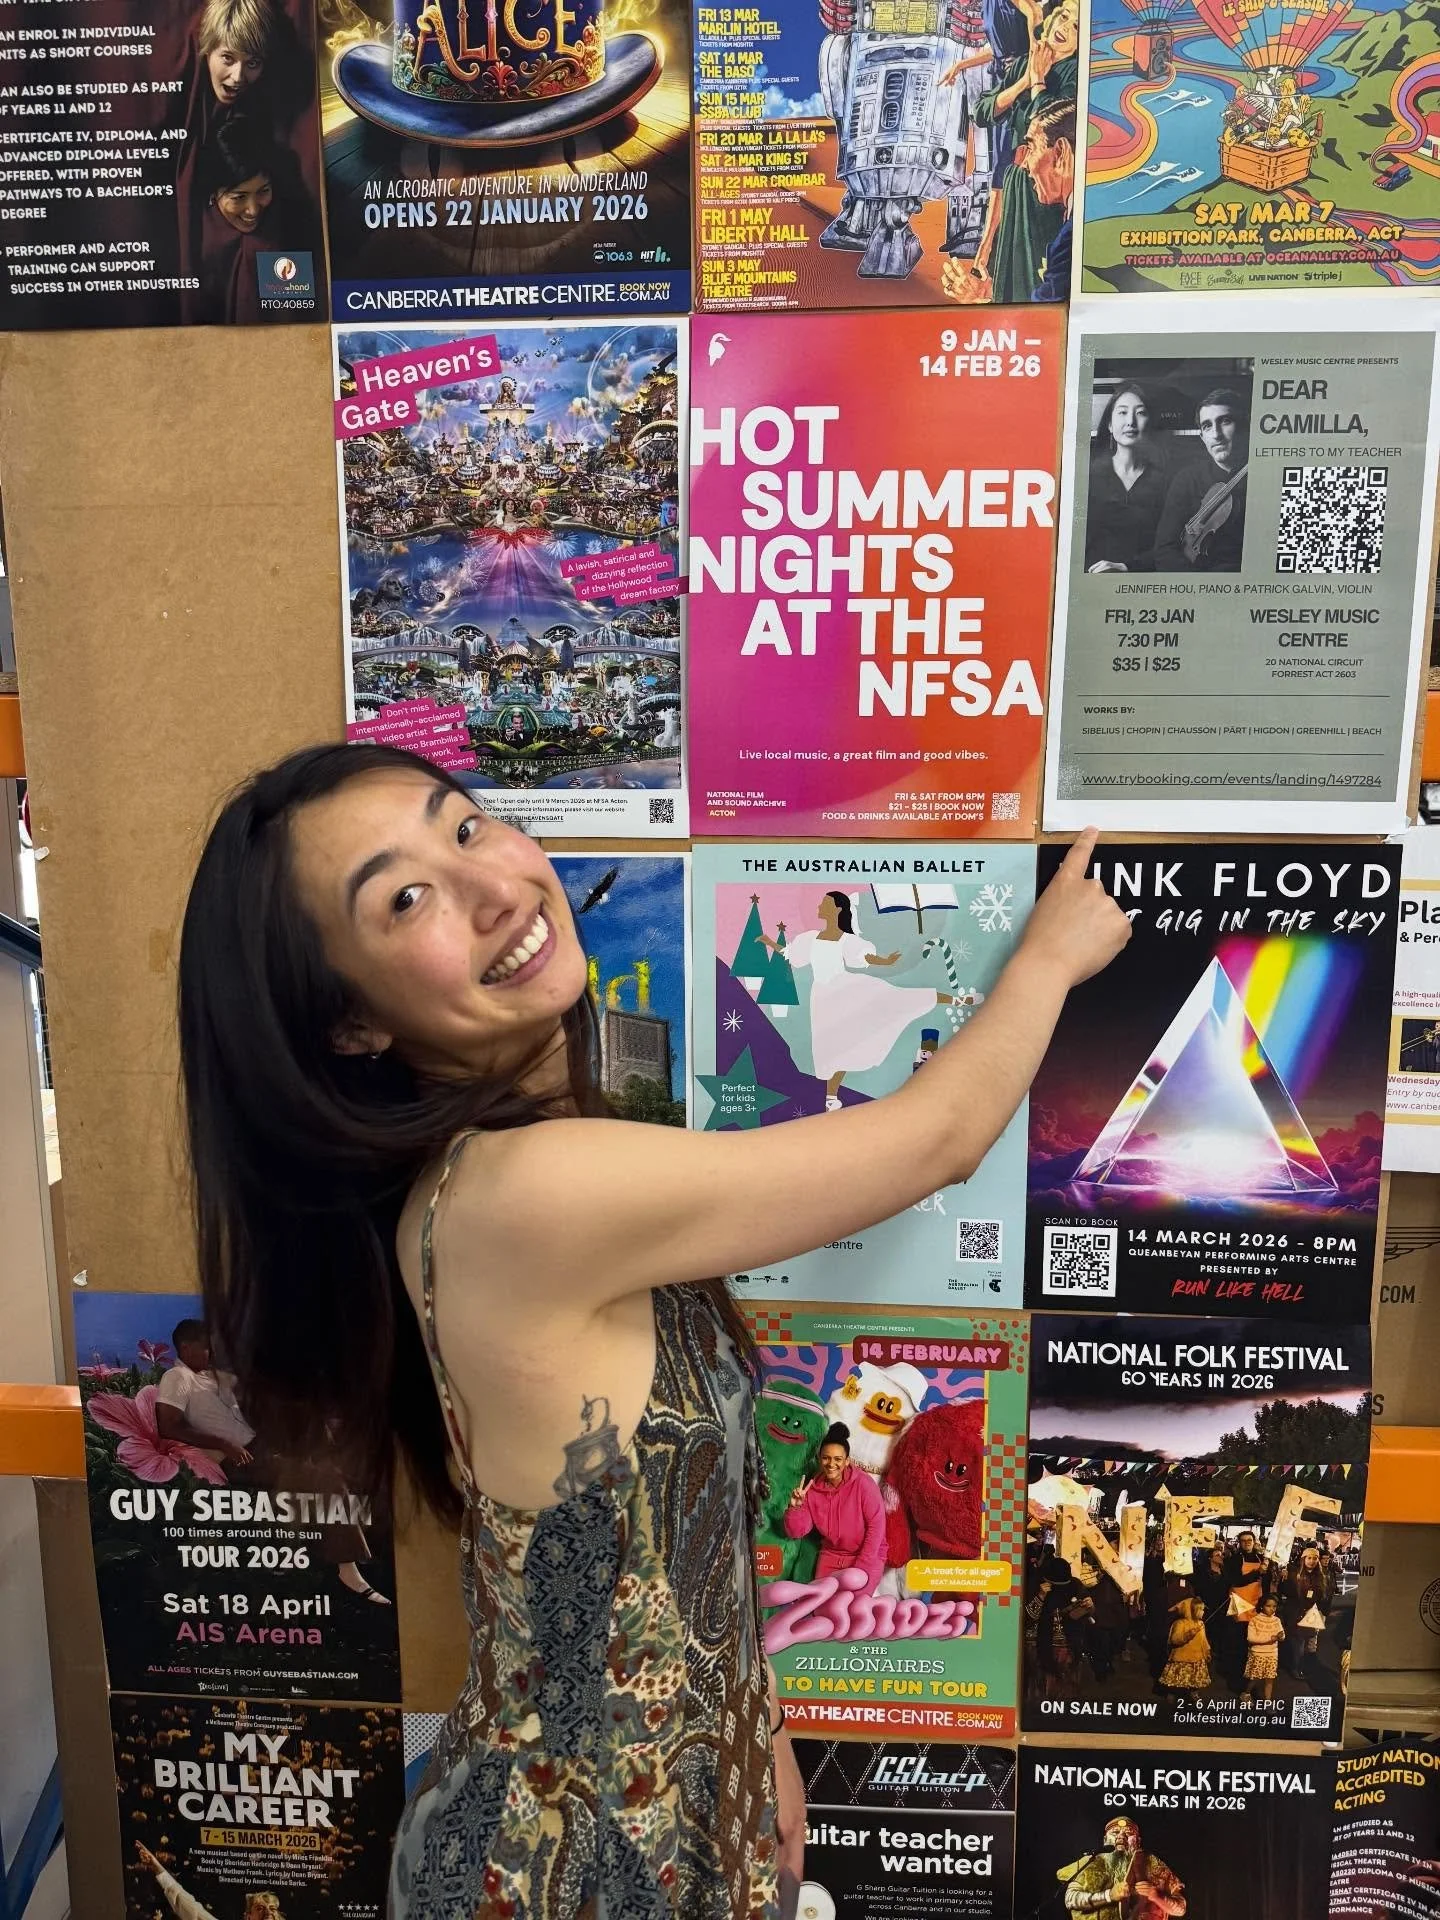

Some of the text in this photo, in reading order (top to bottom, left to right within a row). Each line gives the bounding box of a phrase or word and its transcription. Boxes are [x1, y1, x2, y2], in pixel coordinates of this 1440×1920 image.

[698, 8, 759, 21] FRI 13 MAR
[698, 21, 781, 36] MARLIN HOTEL
[415, 0, 585, 82] ALICE
[364, 171, 648, 200] AN ACROBATIC ADVENTURE IN WONDERLAND
[1, 207, 47, 219] DEGREE
[364, 194, 648, 229] OPENS 22 JANUARY 2026
[701, 207, 773, 226] FRI 1 MAY
[1194, 200, 1334, 226] SAT MAR 7
[701, 224, 809, 243] LIBERTY HALL
[1119, 224, 1403, 247] EXHIBITION PARK, CANBERRA, ACT
[605, 251, 633, 261] 106.3
[1124, 249, 1401, 267] TICKETS AVAILABLE AT OCEANALLEY.COM.AU
[10, 277, 199, 294] SUCCESS IN OTHER INDUSTRIES
[702, 270, 796, 285] BLUE MOUNTAINS
[702, 285, 752, 297] THEATRE
[940, 329, 957, 351] 9
[963, 329, 1016, 351] JAN
[362, 345, 493, 393] Heaven's
[919, 354, 1040, 377] 14 FEB 26
[1262, 379, 1327, 400] DEAR
[341, 398, 410, 431] Gate
[1259, 413, 1368, 437] CAMILLA,
[689, 403, 839, 469] HOT
[1255, 447, 1401, 457] LETTERS TO MY TEACHER
[741, 469, 1055, 530] SUMMER
[567, 548, 654, 572] A lavish, satirical and
[591, 561, 669, 580] dizzying reflection
[688, 533, 953, 593] NIGHTS
[581, 574, 652, 595] of the Hollywood
[620, 583, 679, 600] dream factory
[740, 597, 984, 655] AT THE
[1104, 608, 1194, 626] FRI, 23 JAN
[1249, 608, 1380, 624] WESLEY MUSIC
[1117, 632, 1178, 647] 7:30 PM
[1278, 632, 1348, 647] CENTRE
[858, 659, 1043, 716] NFSA
[739, 749, 762, 759] Live
[764, 749, 791, 759] local
[793, 750, 830, 760] music,
[842, 750, 873, 762] great
[875, 749, 896, 759] film
[899, 749, 920, 759] and
[923, 749, 952, 762] good
[954, 749, 988, 759] vibes.
[742, 859, 985, 872] THE AUSTRALIAN BALLET
[1213, 862, 1390, 898] FLOYD
[1155, 908, 1202, 936] GIG
[1218, 907, 1250, 931] IN
[1266, 909, 1316, 936] THE
[1331, 908, 1386, 936] SKY
[1045, 1217, 1118, 1227] SCAN TO BOOK
[1128, 1229, 1147, 1242] 14
[1155, 1229, 1230, 1245] MARCH
[1239, 1232, 1287, 1247] 2026
[1313, 1236, 1356, 1251] 8PM
[1171, 1278, 1304, 1303] RUN LIKE HELL
[860, 1342, 1001, 1363] 14 FEBRUARY
[1048, 1340, 1349, 1370] NATIONAL FOLK FESTIVAL
[1121, 1370, 1273, 1389] 60 YEARS IN 2026
[109, 1488, 371, 1525] GUY SEBASTIAN
[177, 1545, 309, 1569] TOUR 2026
[163, 1592, 330, 1619] Sat 18 April
[176, 1621, 322, 1644] AIS Arena
[849, 1645, 887, 1654] & THE
[795, 1656, 944, 1673] ZILLIONAIRES
[782, 1676, 987, 1697] TO HAVE FUN TOUR
[1040, 1700, 1157, 1716] ON SALE NOW
[1173, 1711, 1285, 1726] folkfestival.org.au
[223, 1731, 290, 1763] MY
[154, 1758, 359, 1797] BRILLIANT
[1335, 1771, 1425, 1792] ACCREDITED
[177, 1791, 334, 1830] CAREER
[1334, 1790, 1385, 1810] ACTING
[203, 1829, 211, 1842] 7
[221, 1830, 235, 1843] 15
[237, 1831, 282, 1846] MARCH
[285, 1834, 316, 1848] 2026
[804, 1823, 993, 1851] uitar teacher
[880, 1853, 992, 1875] wanted
